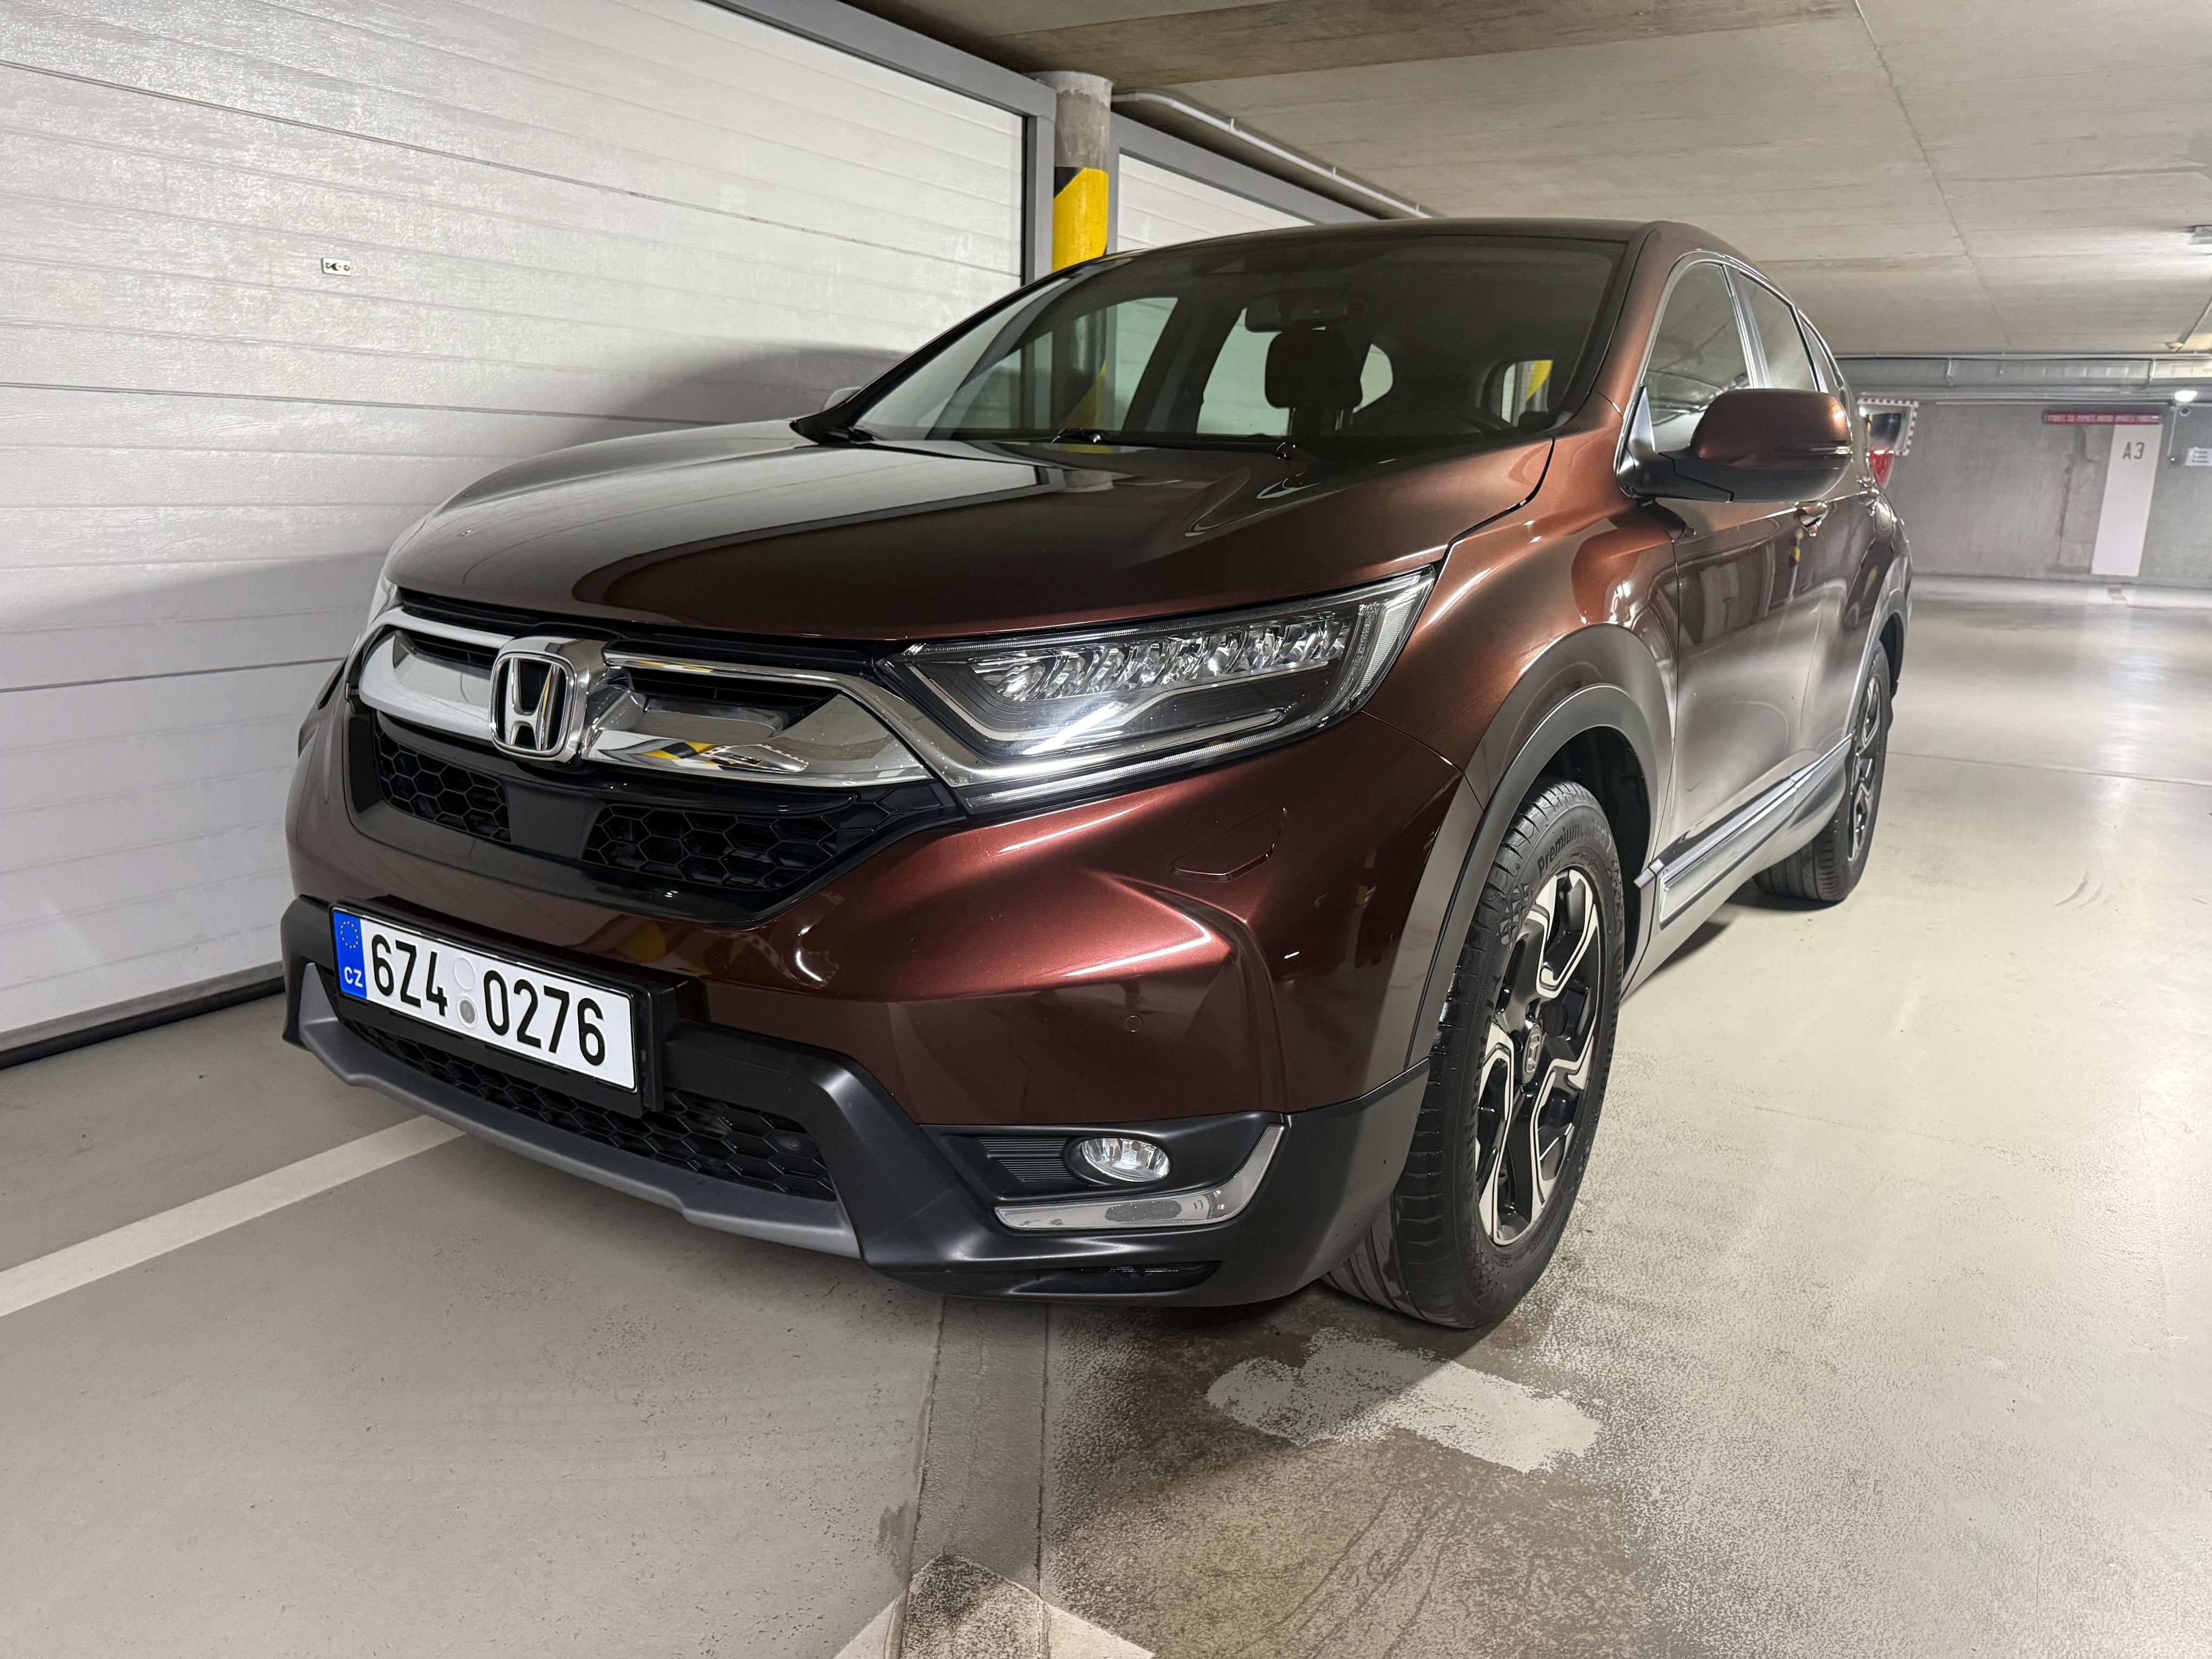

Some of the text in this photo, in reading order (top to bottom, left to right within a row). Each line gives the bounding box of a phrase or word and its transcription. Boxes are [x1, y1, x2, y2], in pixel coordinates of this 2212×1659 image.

[2122, 441, 2145, 460] A3
[344, 966, 363, 988] CZ
[371, 934, 606, 1067] 6Z4 0276
